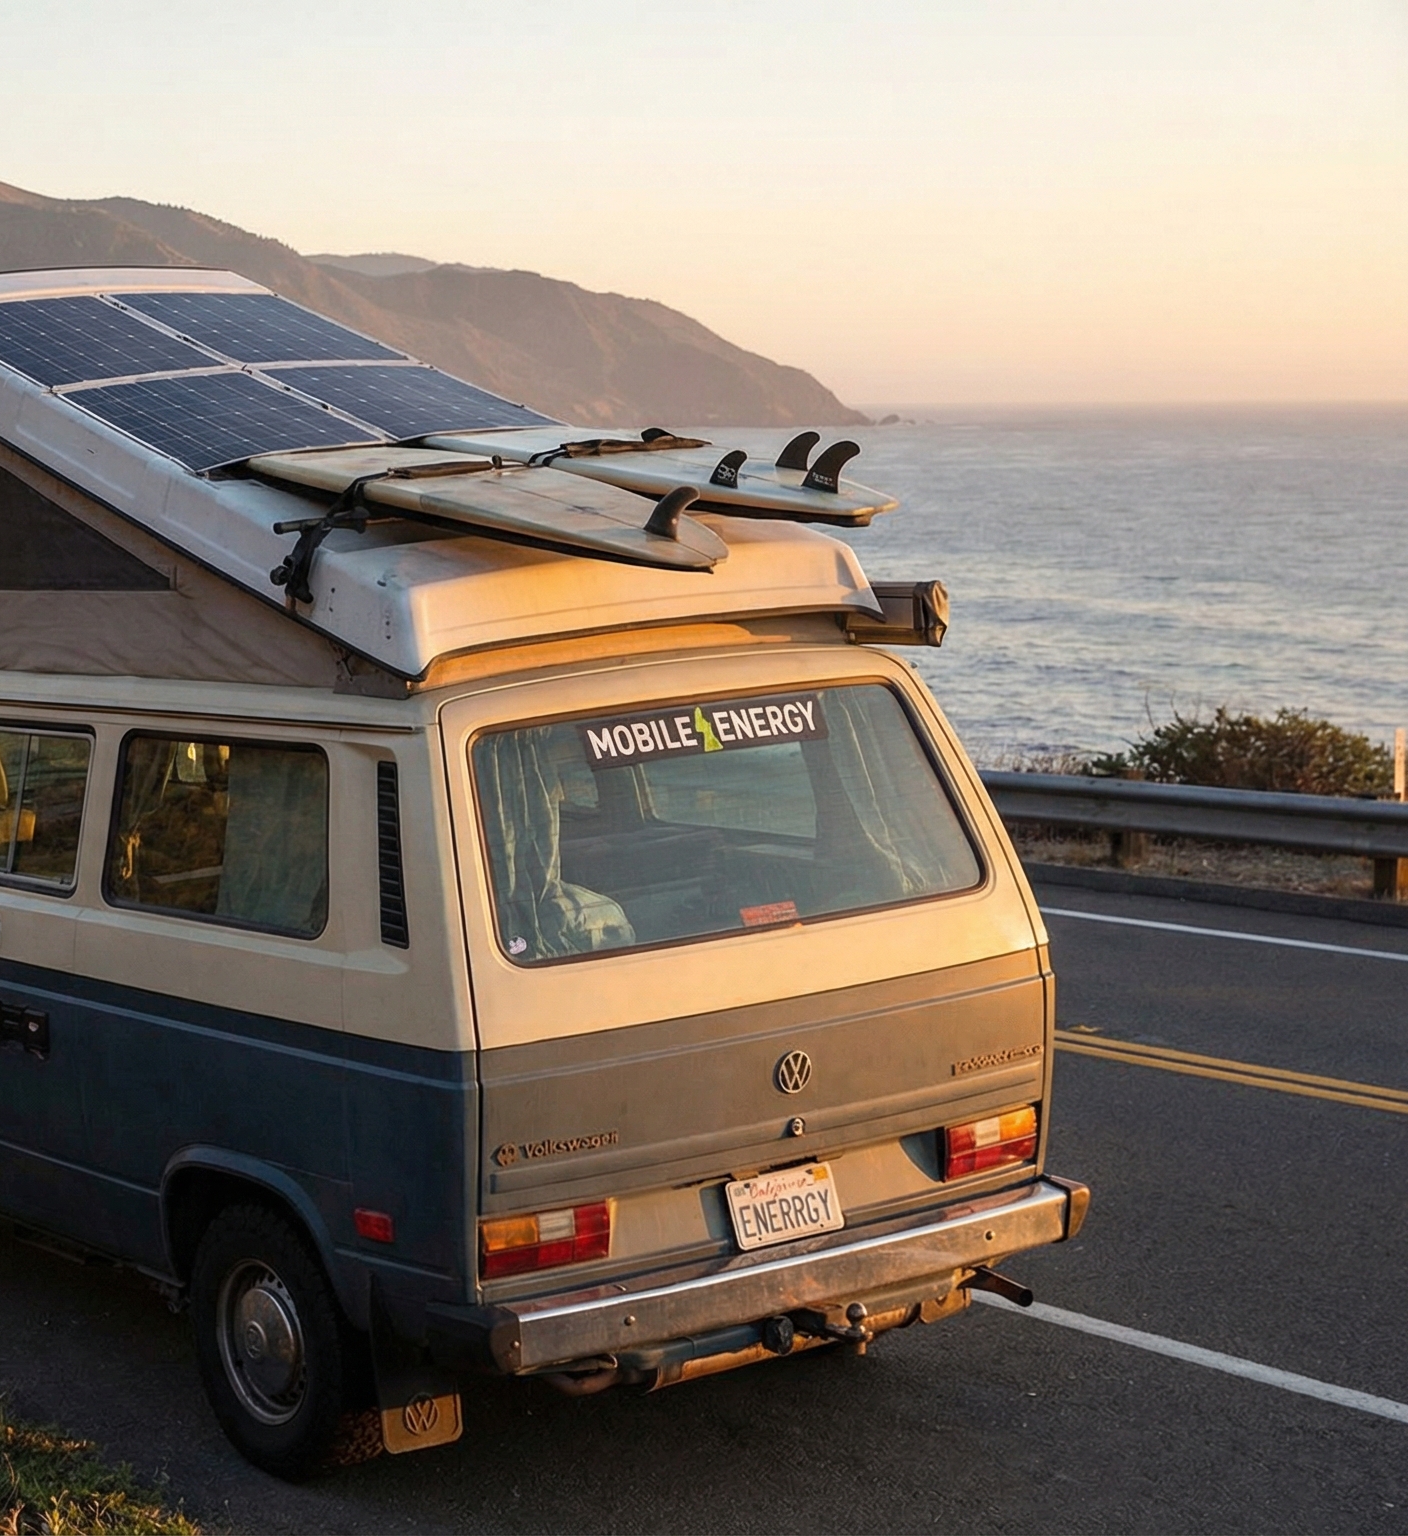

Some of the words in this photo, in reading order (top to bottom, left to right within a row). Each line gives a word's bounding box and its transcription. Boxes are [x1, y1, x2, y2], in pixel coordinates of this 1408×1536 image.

[587, 715, 698, 760] MOBILE
[712, 700, 816, 742] ENERGY
[779, 1050, 812, 1094] VW
[739, 1189, 831, 1239] ENERRGY
